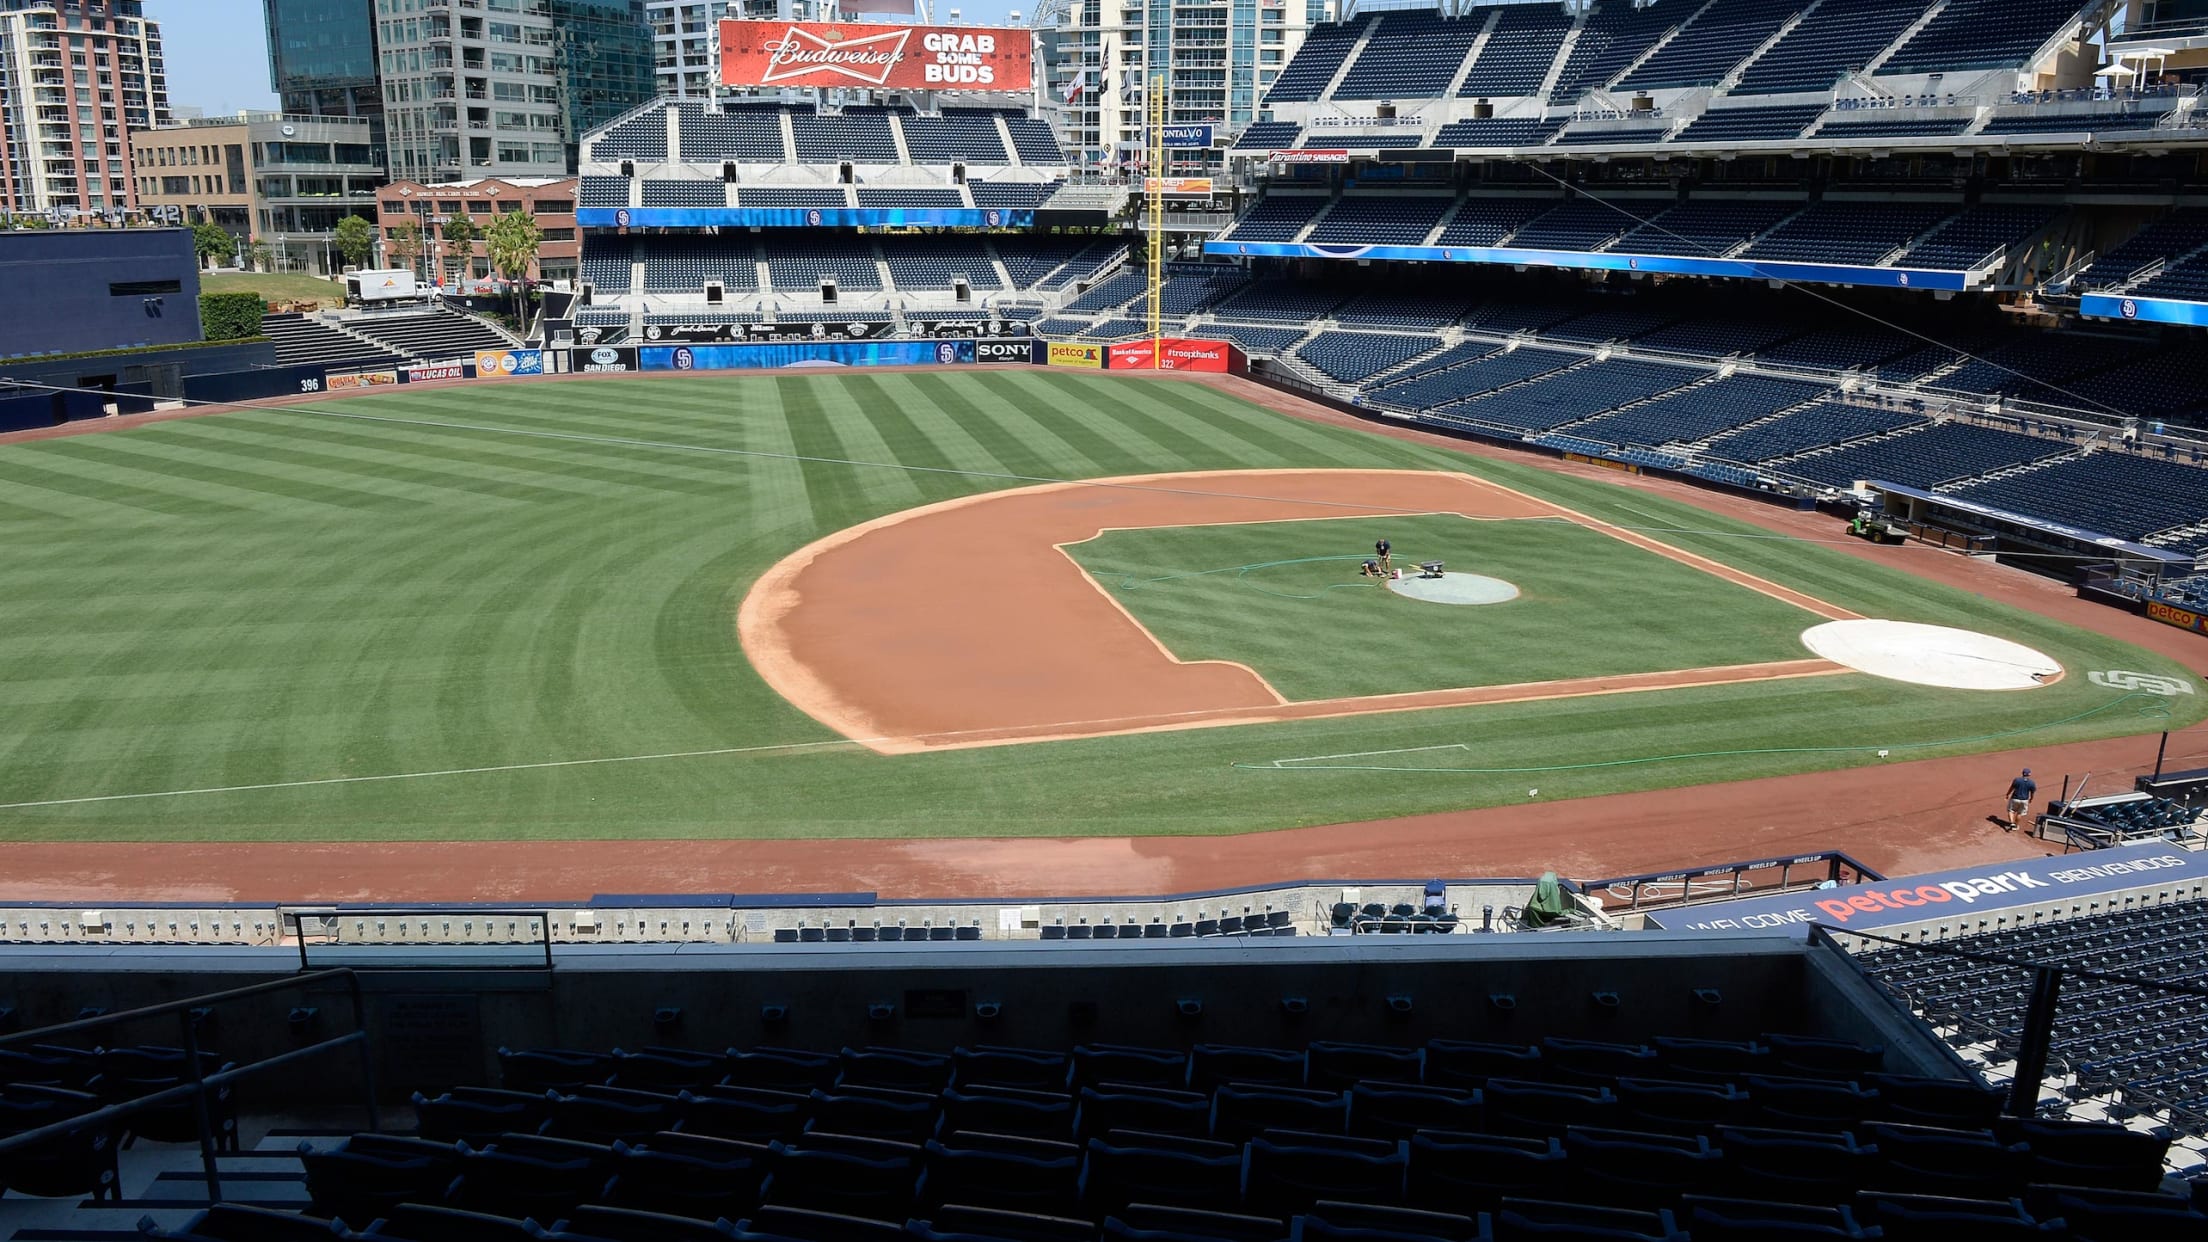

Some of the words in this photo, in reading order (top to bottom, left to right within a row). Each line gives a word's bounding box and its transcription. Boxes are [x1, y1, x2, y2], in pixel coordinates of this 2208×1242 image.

[924, 34, 995, 54] GRAB
[764, 41, 904, 64] Budweiser
[936, 53, 982, 65] SOME
[924, 64, 994, 83] BUDS
[153, 205, 180, 223] 42
[979, 345, 1030, 355] SONY
[1051, 347, 1084, 357] petco
[1167, 349, 1219, 360] #troopthanks
[583, 363, 601, 373] SAN
[601, 363, 627, 373] DIEGO
[1161, 360, 1174, 369] 322
[421, 369, 448, 379] LUCAS
[448, 367, 461, 377] OIL
[301, 378, 319, 392] 396
[2149, 603, 2191, 625] petco
[2048, 855, 2187, 884] BIENVENIDOS
